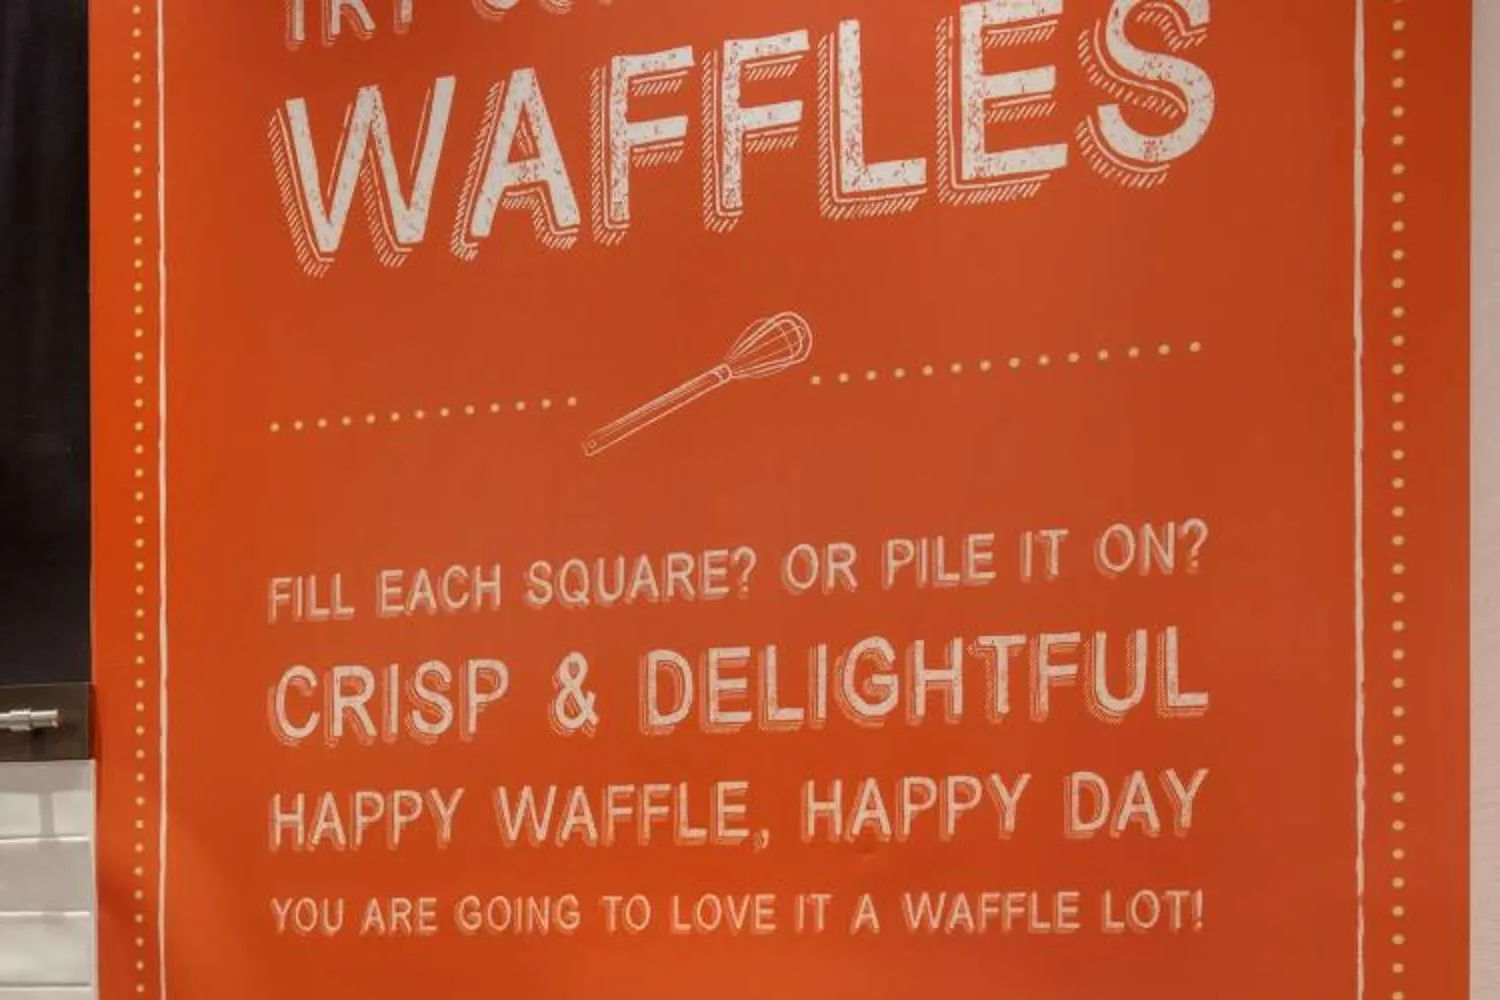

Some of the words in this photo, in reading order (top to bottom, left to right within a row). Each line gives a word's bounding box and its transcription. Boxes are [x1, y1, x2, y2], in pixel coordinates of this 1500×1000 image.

[269, 0, 1215, 277] WAFFLES
[269, 576, 356, 622] FILL
[376, 563, 503, 616] EACH
[525, 546, 757, 610] SQUARE?
[781, 543, 859, 593] OR
[885, 533, 997, 590] PILE
[1019, 527, 1071, 580] IT
[1095, 517, 1210, 575] ON?
[269, 657, 511, 748] CRISP
[549, 651, 601, 738] &
[640, 625, 1211, 737] DELIGHTFUL
[269, 786, 465, 853] HAPPY
[496, 780, 772, 852] WAFFLE,
[801, 772, 1033, 842] HAPPY
[1063, 767, 1209, 839] DAY
[270, 896, 346, 937] YOU
[360, 895, 439, 936] ARE
[456, 893, 582, 935] GOING
[602, 893, 652, 934] TO
[670, 892, 778, 933] LOVE
[794, 891, 834, 933] IT
[849, 891, 882, 933] A
[900, 889, 1082, 932] WAFFLE
[1100, 887, 1206, 932] LOT!
